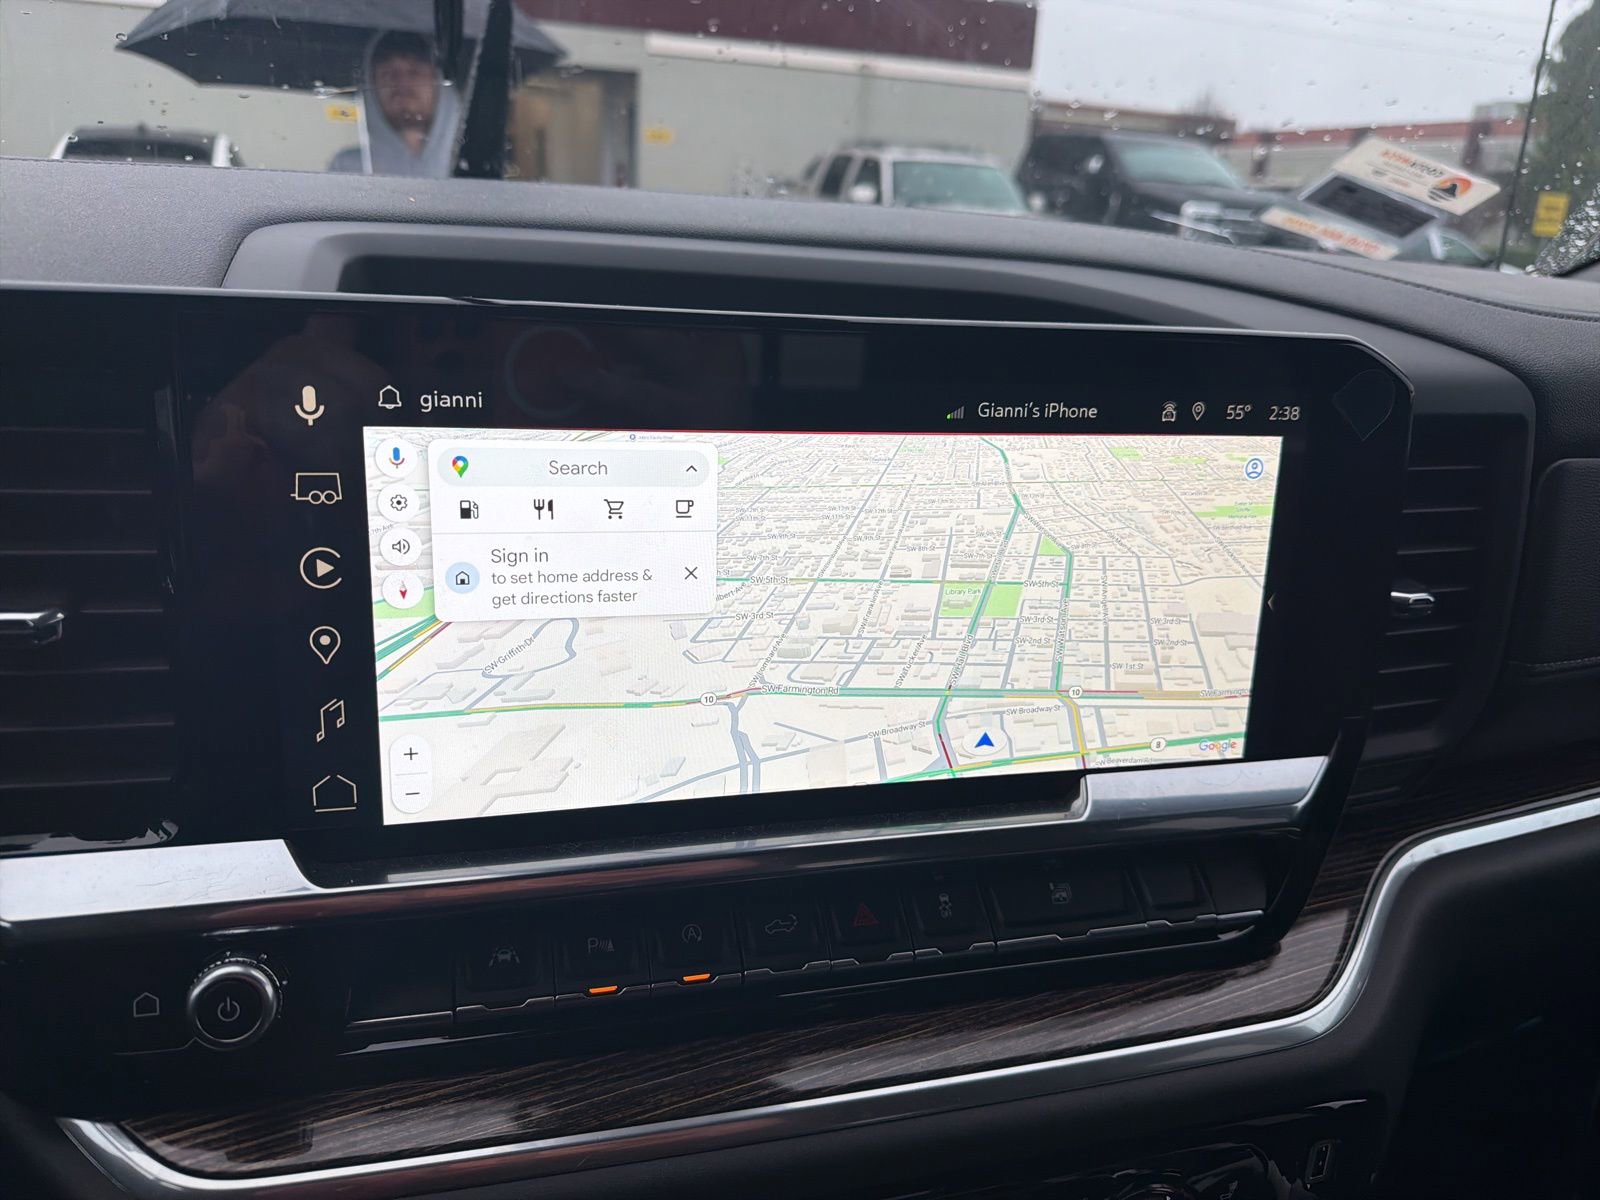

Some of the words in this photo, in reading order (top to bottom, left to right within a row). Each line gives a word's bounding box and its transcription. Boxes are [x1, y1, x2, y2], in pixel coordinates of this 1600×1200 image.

[420, 391, 483, 412] gianni
[978, 402, 1040, 419] Gianni's
[1044, 403, 1098, 419] iPhone
[1269, 405, 1301, 421] 2:38
[549, 460, 608, 476] Search
[491, 549, 530, 567] Sign
[534, 548, 549, 563] in
[491, 571, 506, 584] to
[510, 570, 533, 584] set
[537, 569, 578, 583] home
[582, 569, 639, 583] address
[642, 569, 653, 582] &
[750, 575, 763, 584] SW
[765, 574, 777, 583] 5th
[779, 574, 788, 583] St
[1100, 575, 1107, 587] SW
[735, 582, 747, 594] Ave
[1023, 580, 1036, 588] SW
[1038, 580, 1049, 588] 5th
[1050, 580, 1059, 588] St
[491, 594, 516, 609] get
[520, 590, 594, 607] directions
[597, 589, 638, 603] faster
[945, 588, 966, 597] Library
[1099, 589, 1108, 610] Angel
[735, 612, 749, 621] SW
[751, 611, 764, 620] 3rd
[765, 611, 774, 619] St
[858, 623, 866, 633] SW
[1057, 615, 1067, 644] Watson
[485, 660, 498, 674] SW
[498, 645, 525, 664] Griffith
[524, 637, 535, 647] Dr
[749, 675, 759, 687] SW
[756, 645, 778, 675] Lombard
[775, 633, 786, 645] Ave
[895, 673, 905, 686] SW
[902, 648, 919, 672] Tucker
[916, 633, 927, 647] Ave
[949, 671, 959, 684] SW
[955, 653, 965, 669] Hall
[961, 634, 973, 651] Blvd
[1056, 649, 1062, 661] SW
[761, 685, 778, 693] SW
[779, 684, 827, 695] Farmington
[828, 686, 839, 695] Rd
[1071, 688, 1081, 696] 10
[1200, 690, 1214, 698] SW
[704, 695, 714, 704] 10
[1019, 705, 1053, 715] Broadway
[1054, 704, 1061, 712] St
[868, 731, 880, 739] SW
[881, 723, 917, 736] Broadway
[918, 721, 926, 729] St
[1200, 739, 1237, 753] Google
